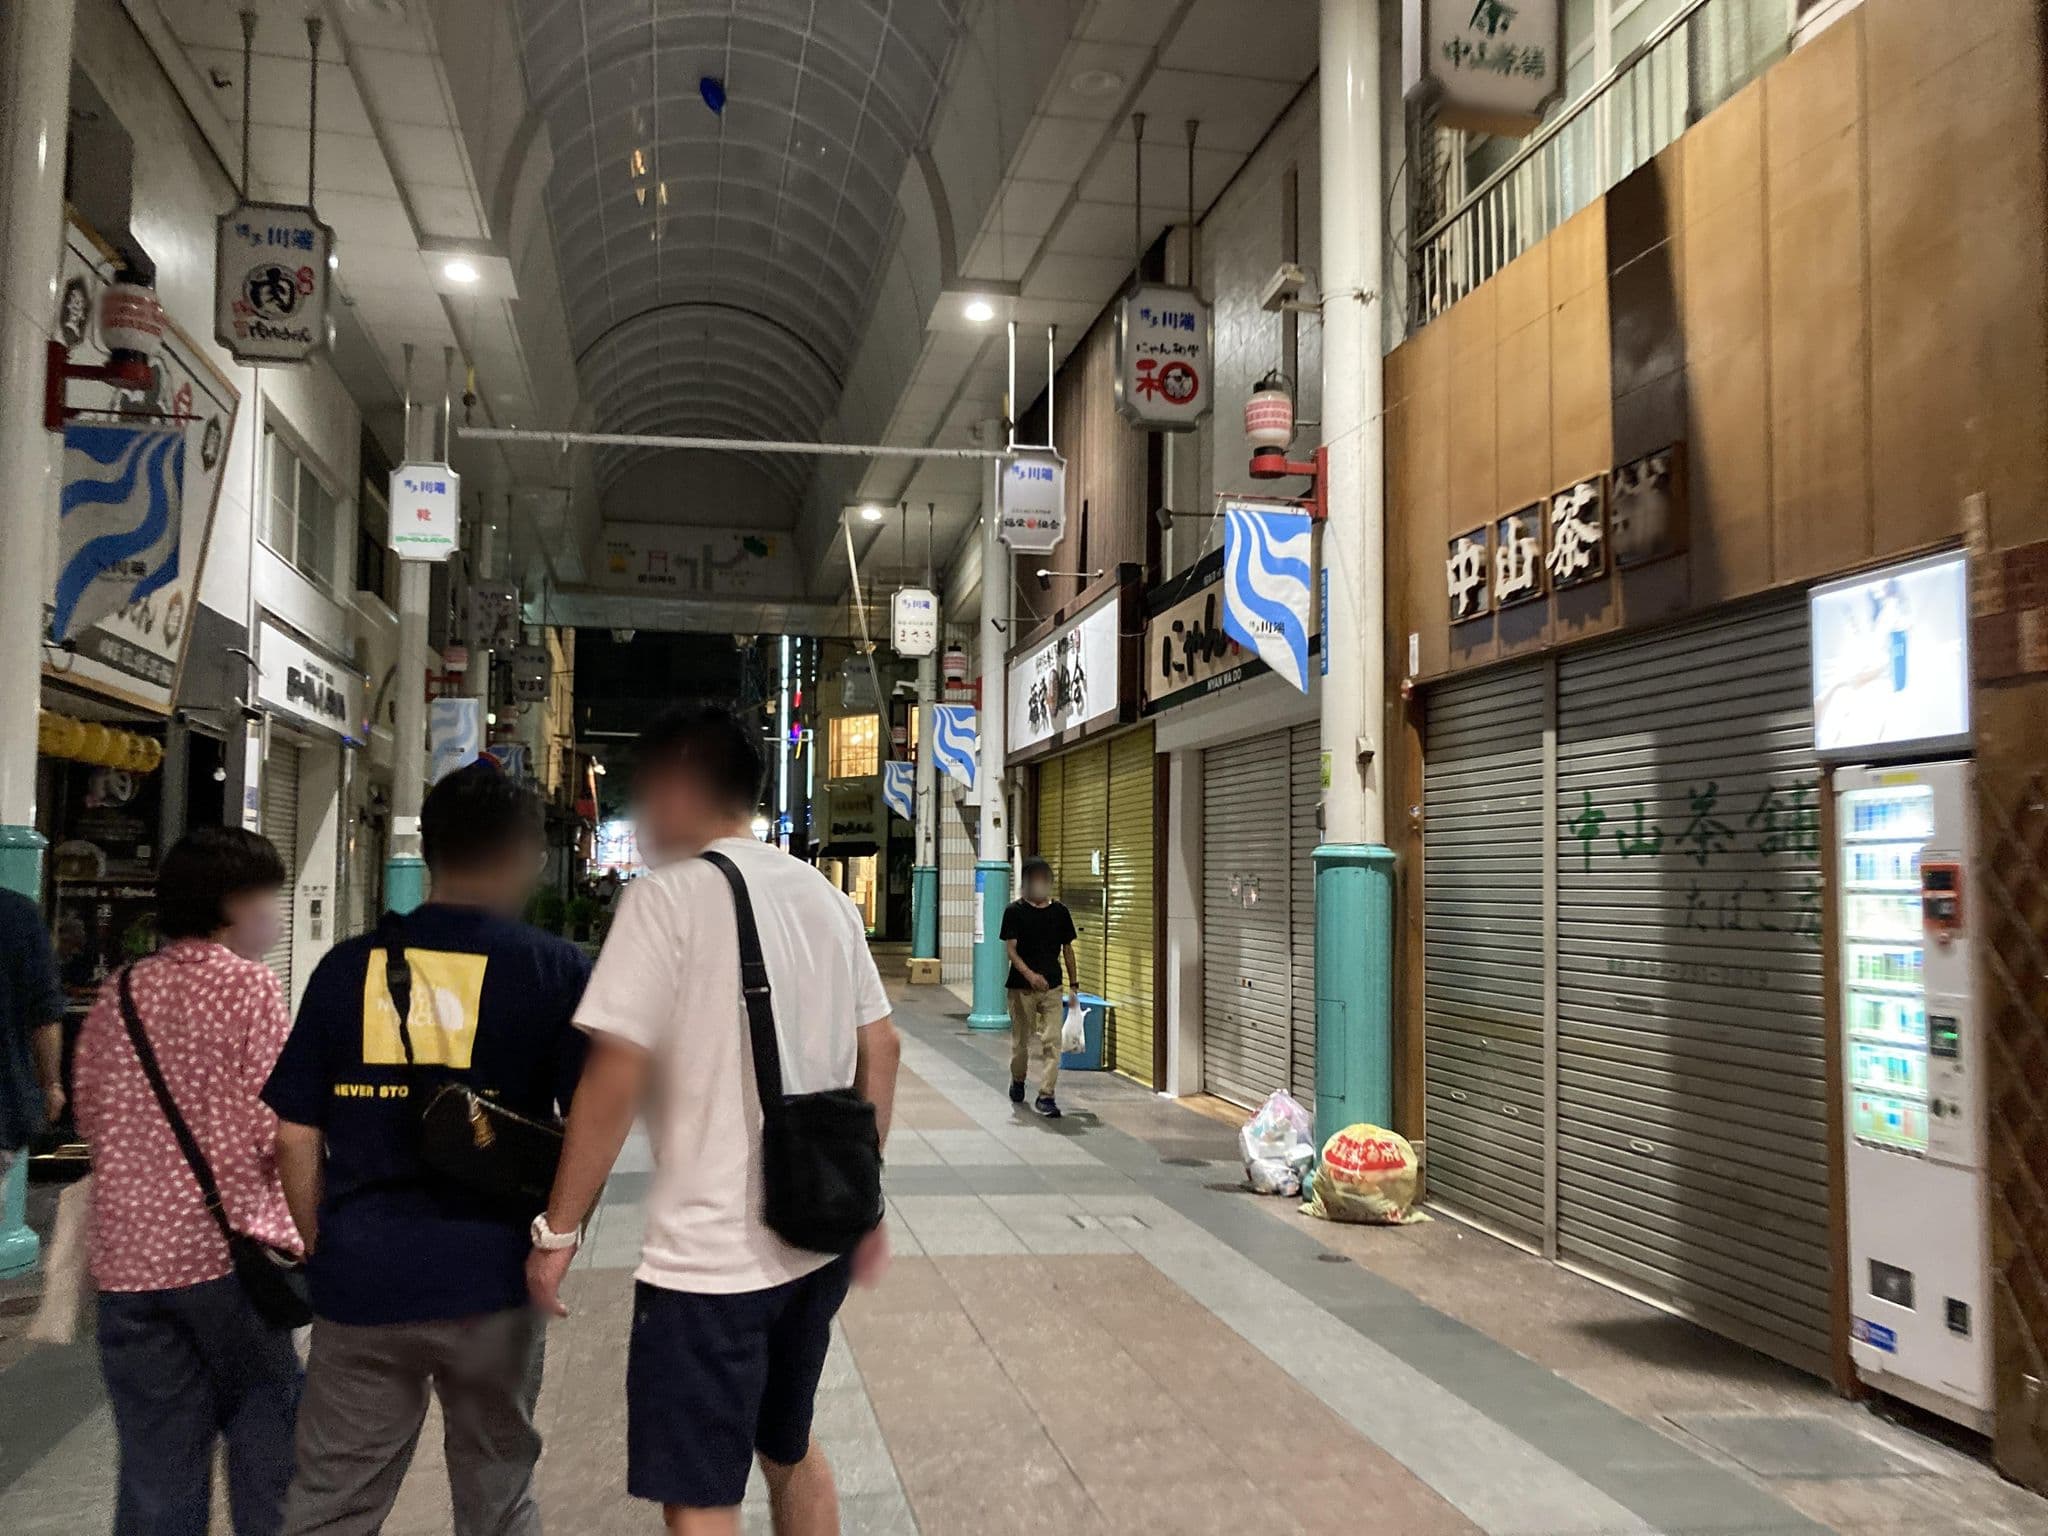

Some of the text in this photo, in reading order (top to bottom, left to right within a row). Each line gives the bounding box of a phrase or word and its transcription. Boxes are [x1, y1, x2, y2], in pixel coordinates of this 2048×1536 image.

[1446, 456, 1668, 615] 中山茶
[379, 1085, 410, 1098] STO
